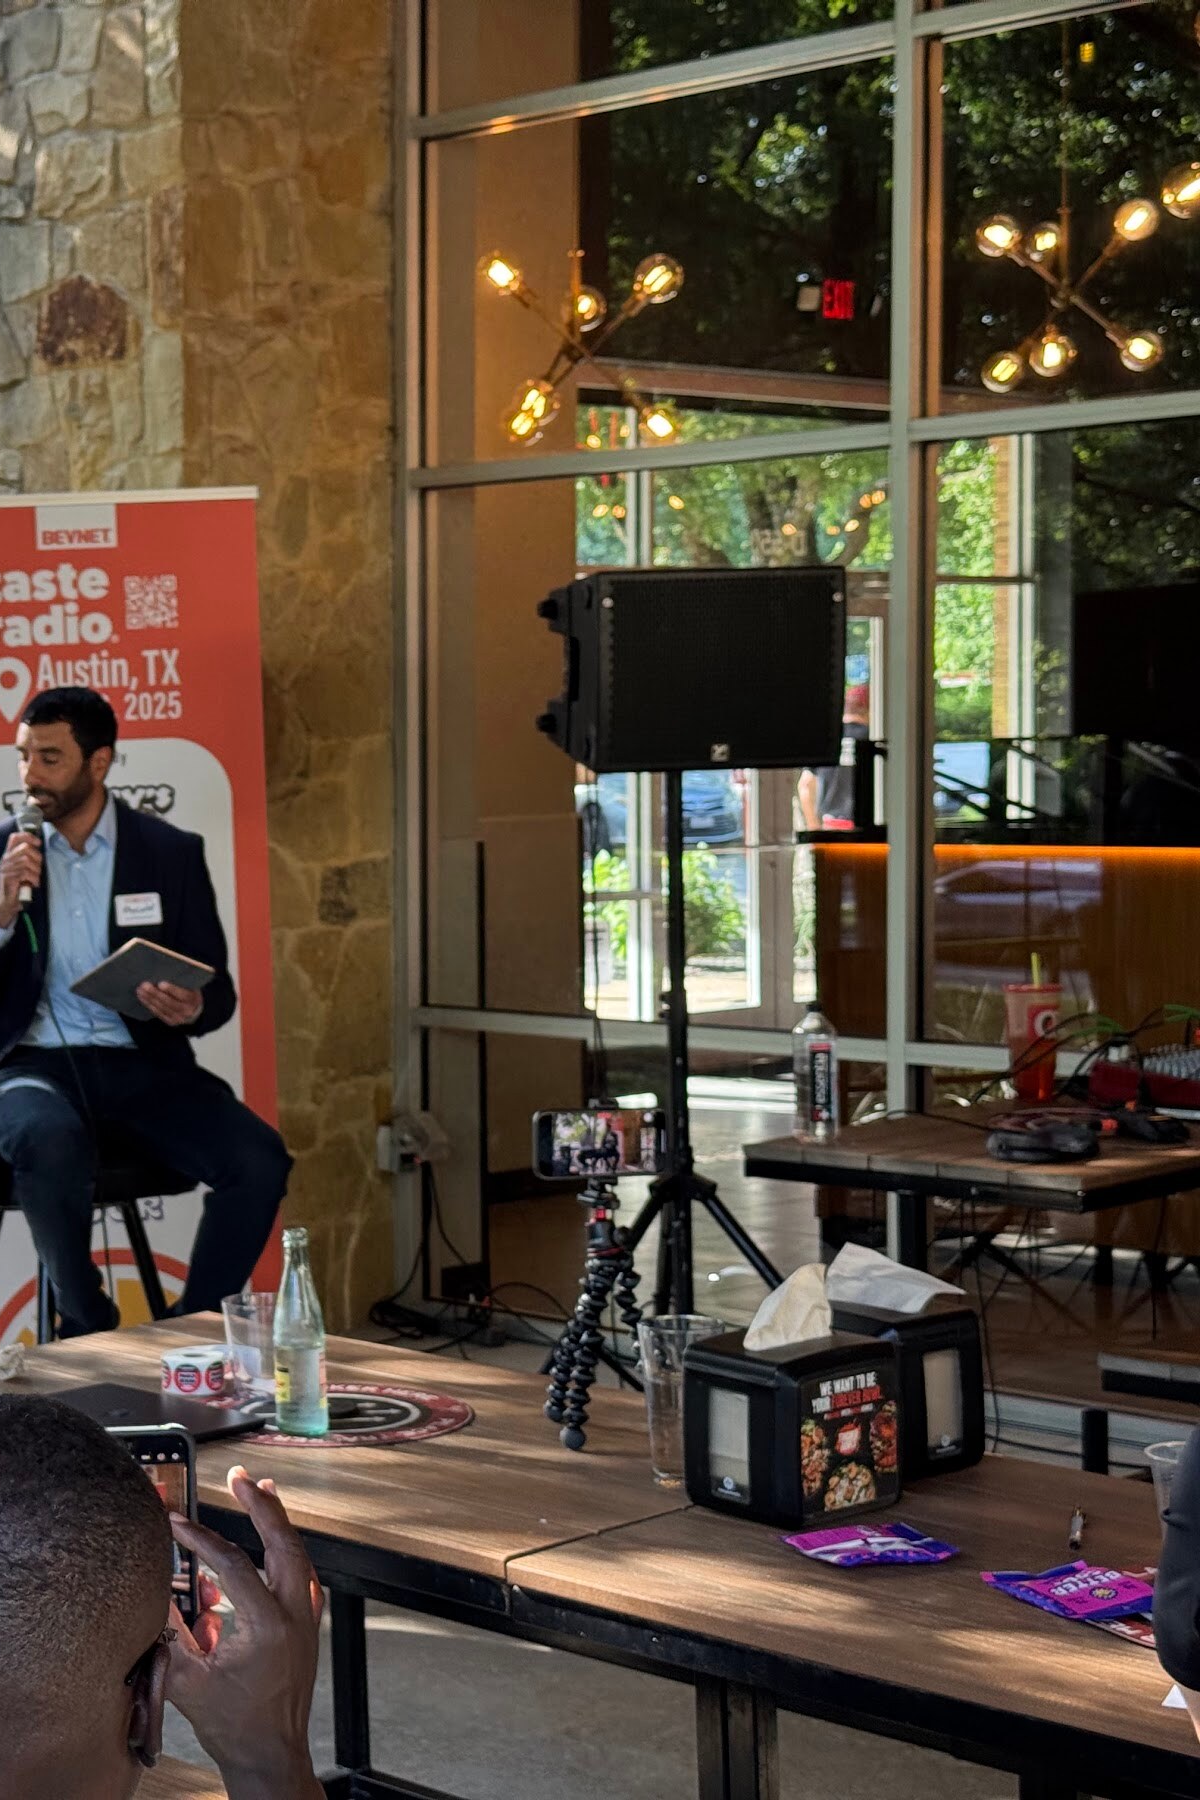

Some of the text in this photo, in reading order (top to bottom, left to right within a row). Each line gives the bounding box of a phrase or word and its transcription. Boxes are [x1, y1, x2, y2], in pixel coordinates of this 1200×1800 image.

[36, 648, 182, 690] Austin, TX
[124, 691, 183, 721] 2025
[1050, 1570, 1122, 1596] BETTER
